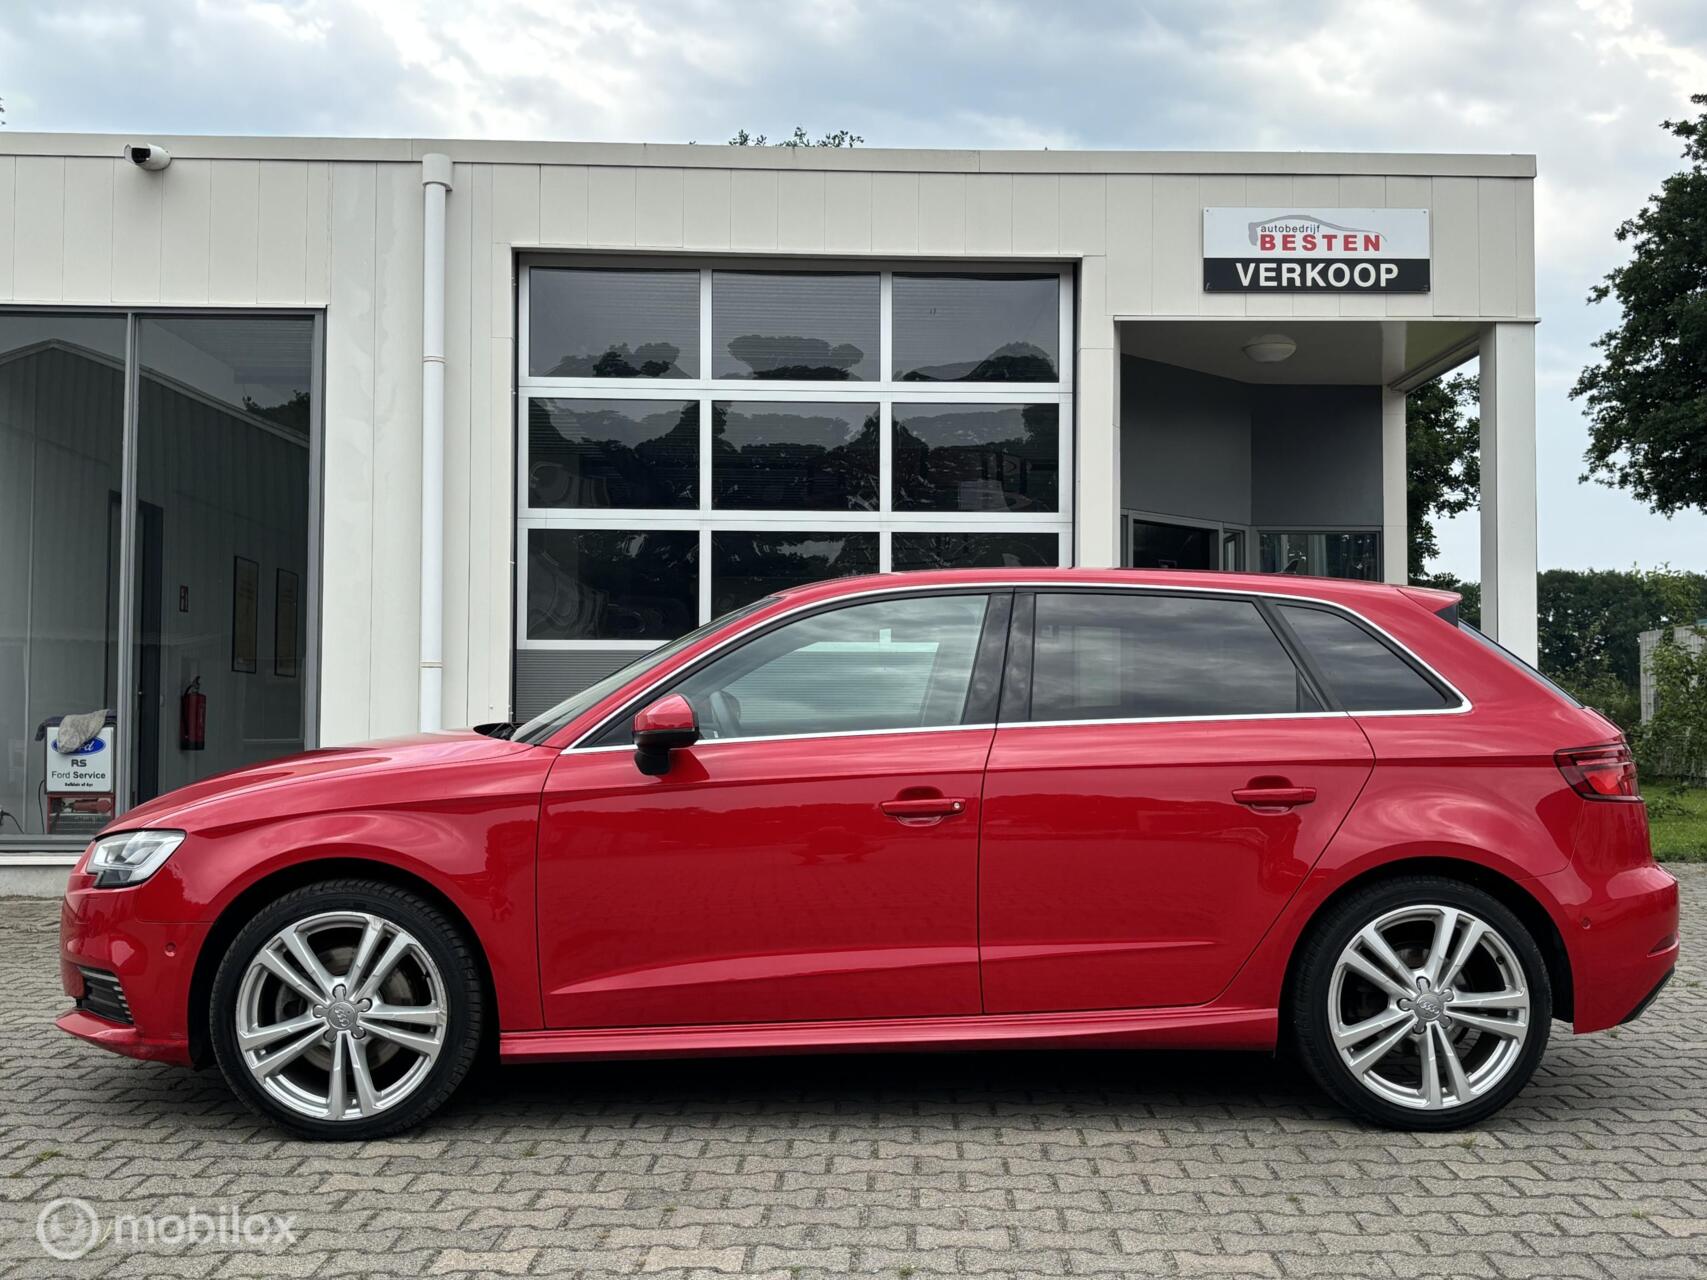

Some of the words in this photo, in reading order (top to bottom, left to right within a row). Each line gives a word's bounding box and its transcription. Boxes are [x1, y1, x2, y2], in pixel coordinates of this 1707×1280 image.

[1260, 224, 1320, 234] autobedrijf
[1260, 234, 1380, 252] BESTEN
[1235, 263, 1399, 287] VERKOOP
[71, 759, 87, 767] RS
[51, 771, 71, 779] Ford
[73, 771, 106, 779] Service
